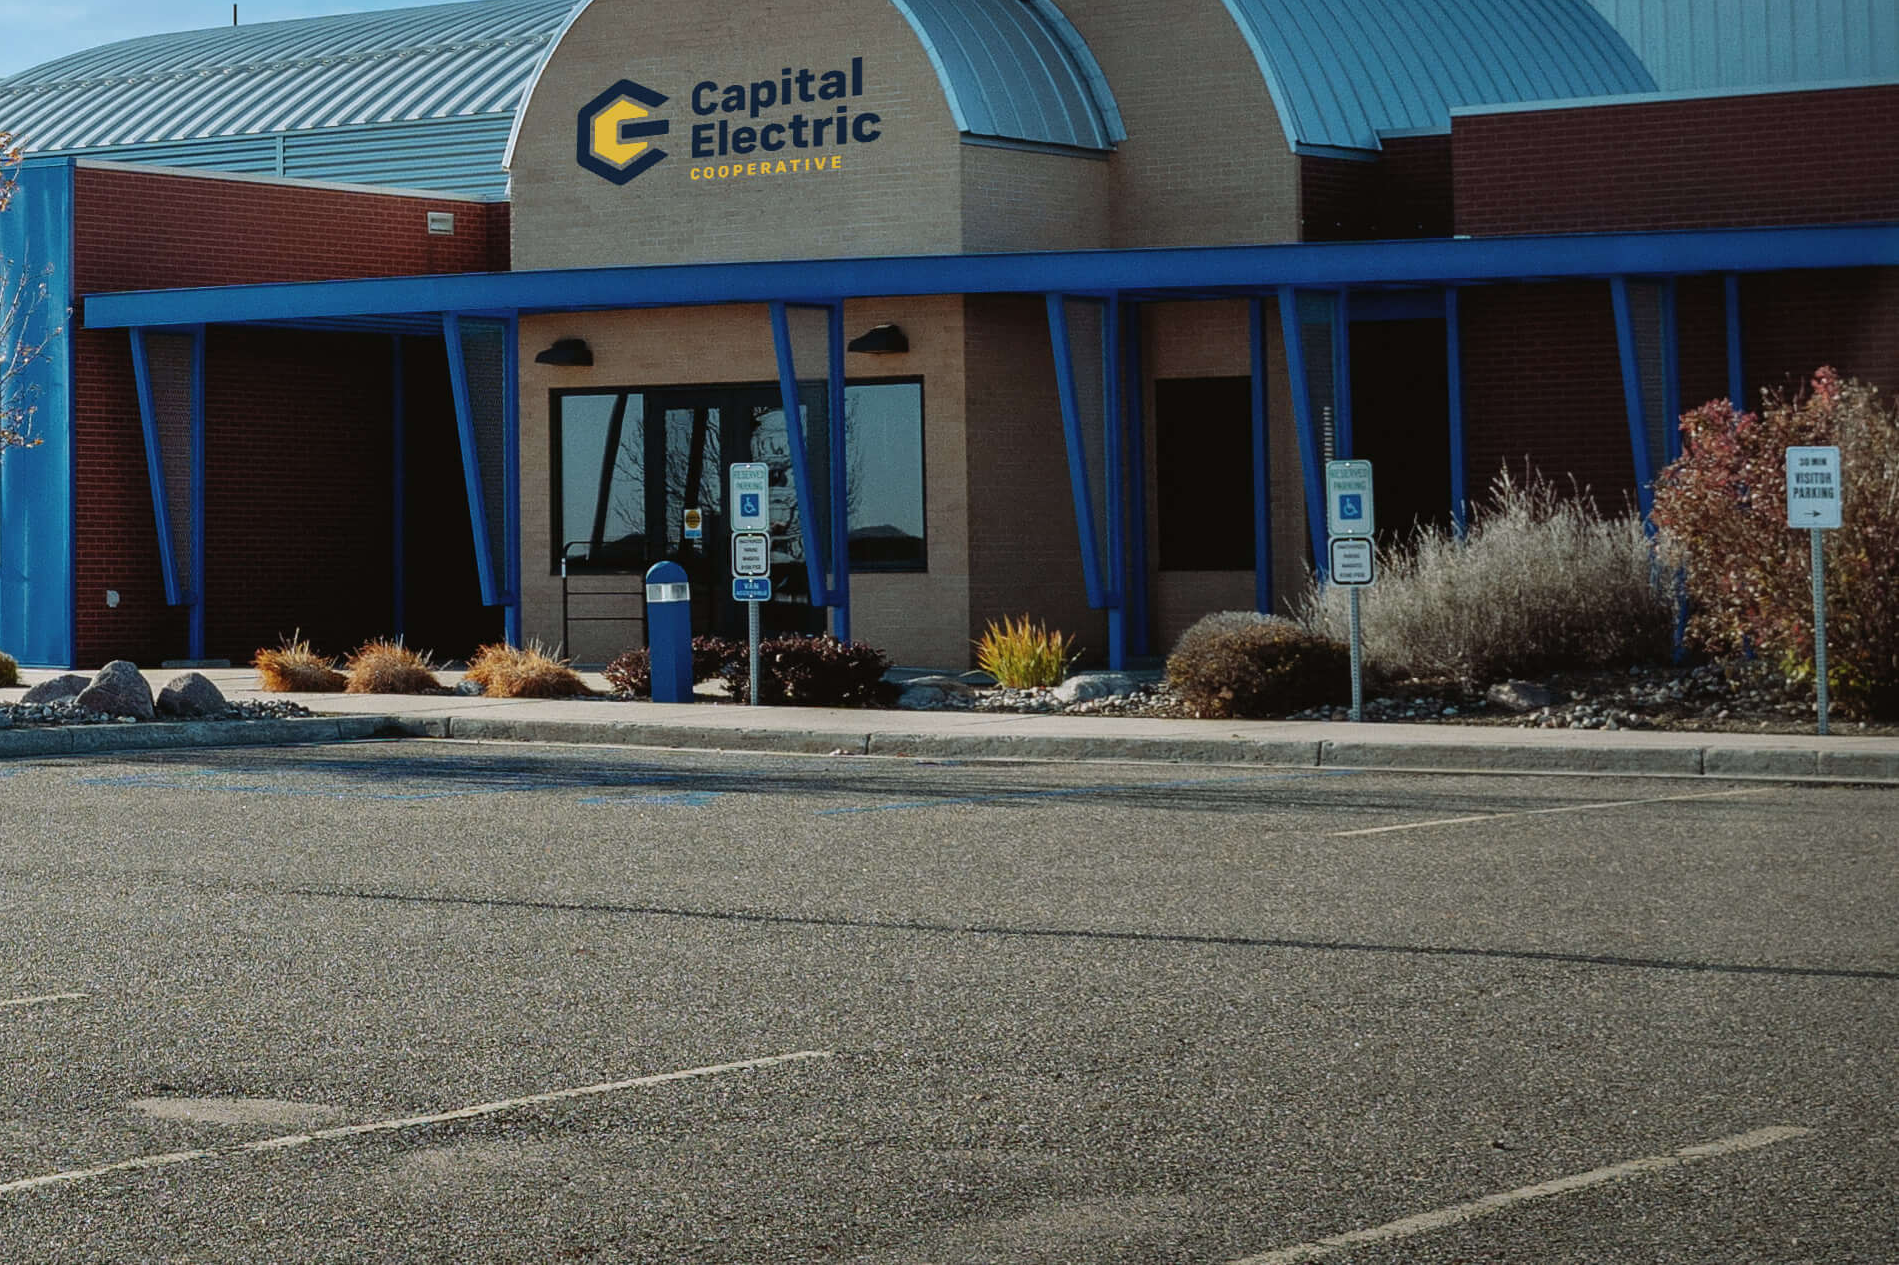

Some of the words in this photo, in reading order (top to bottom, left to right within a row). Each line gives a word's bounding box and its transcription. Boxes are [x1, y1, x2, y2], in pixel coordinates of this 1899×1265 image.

[691, 56, 863, 118] Capital
[691, 105, 882, 158] Electric
[689, 155, 843, 180] COOPERATIVE
[1811, 457, 1827, 466] MIN
[733, 470, 764, 479] RESERVED
[1330, 468, 1368, 478] RESERVED
[1795, 472, 1832, 484] VISITOR
[1333, 481, 1367, 491] PARKING
[1793, 487, 1834, 499] PARKING
[743, 582, 760, 590] VAN
